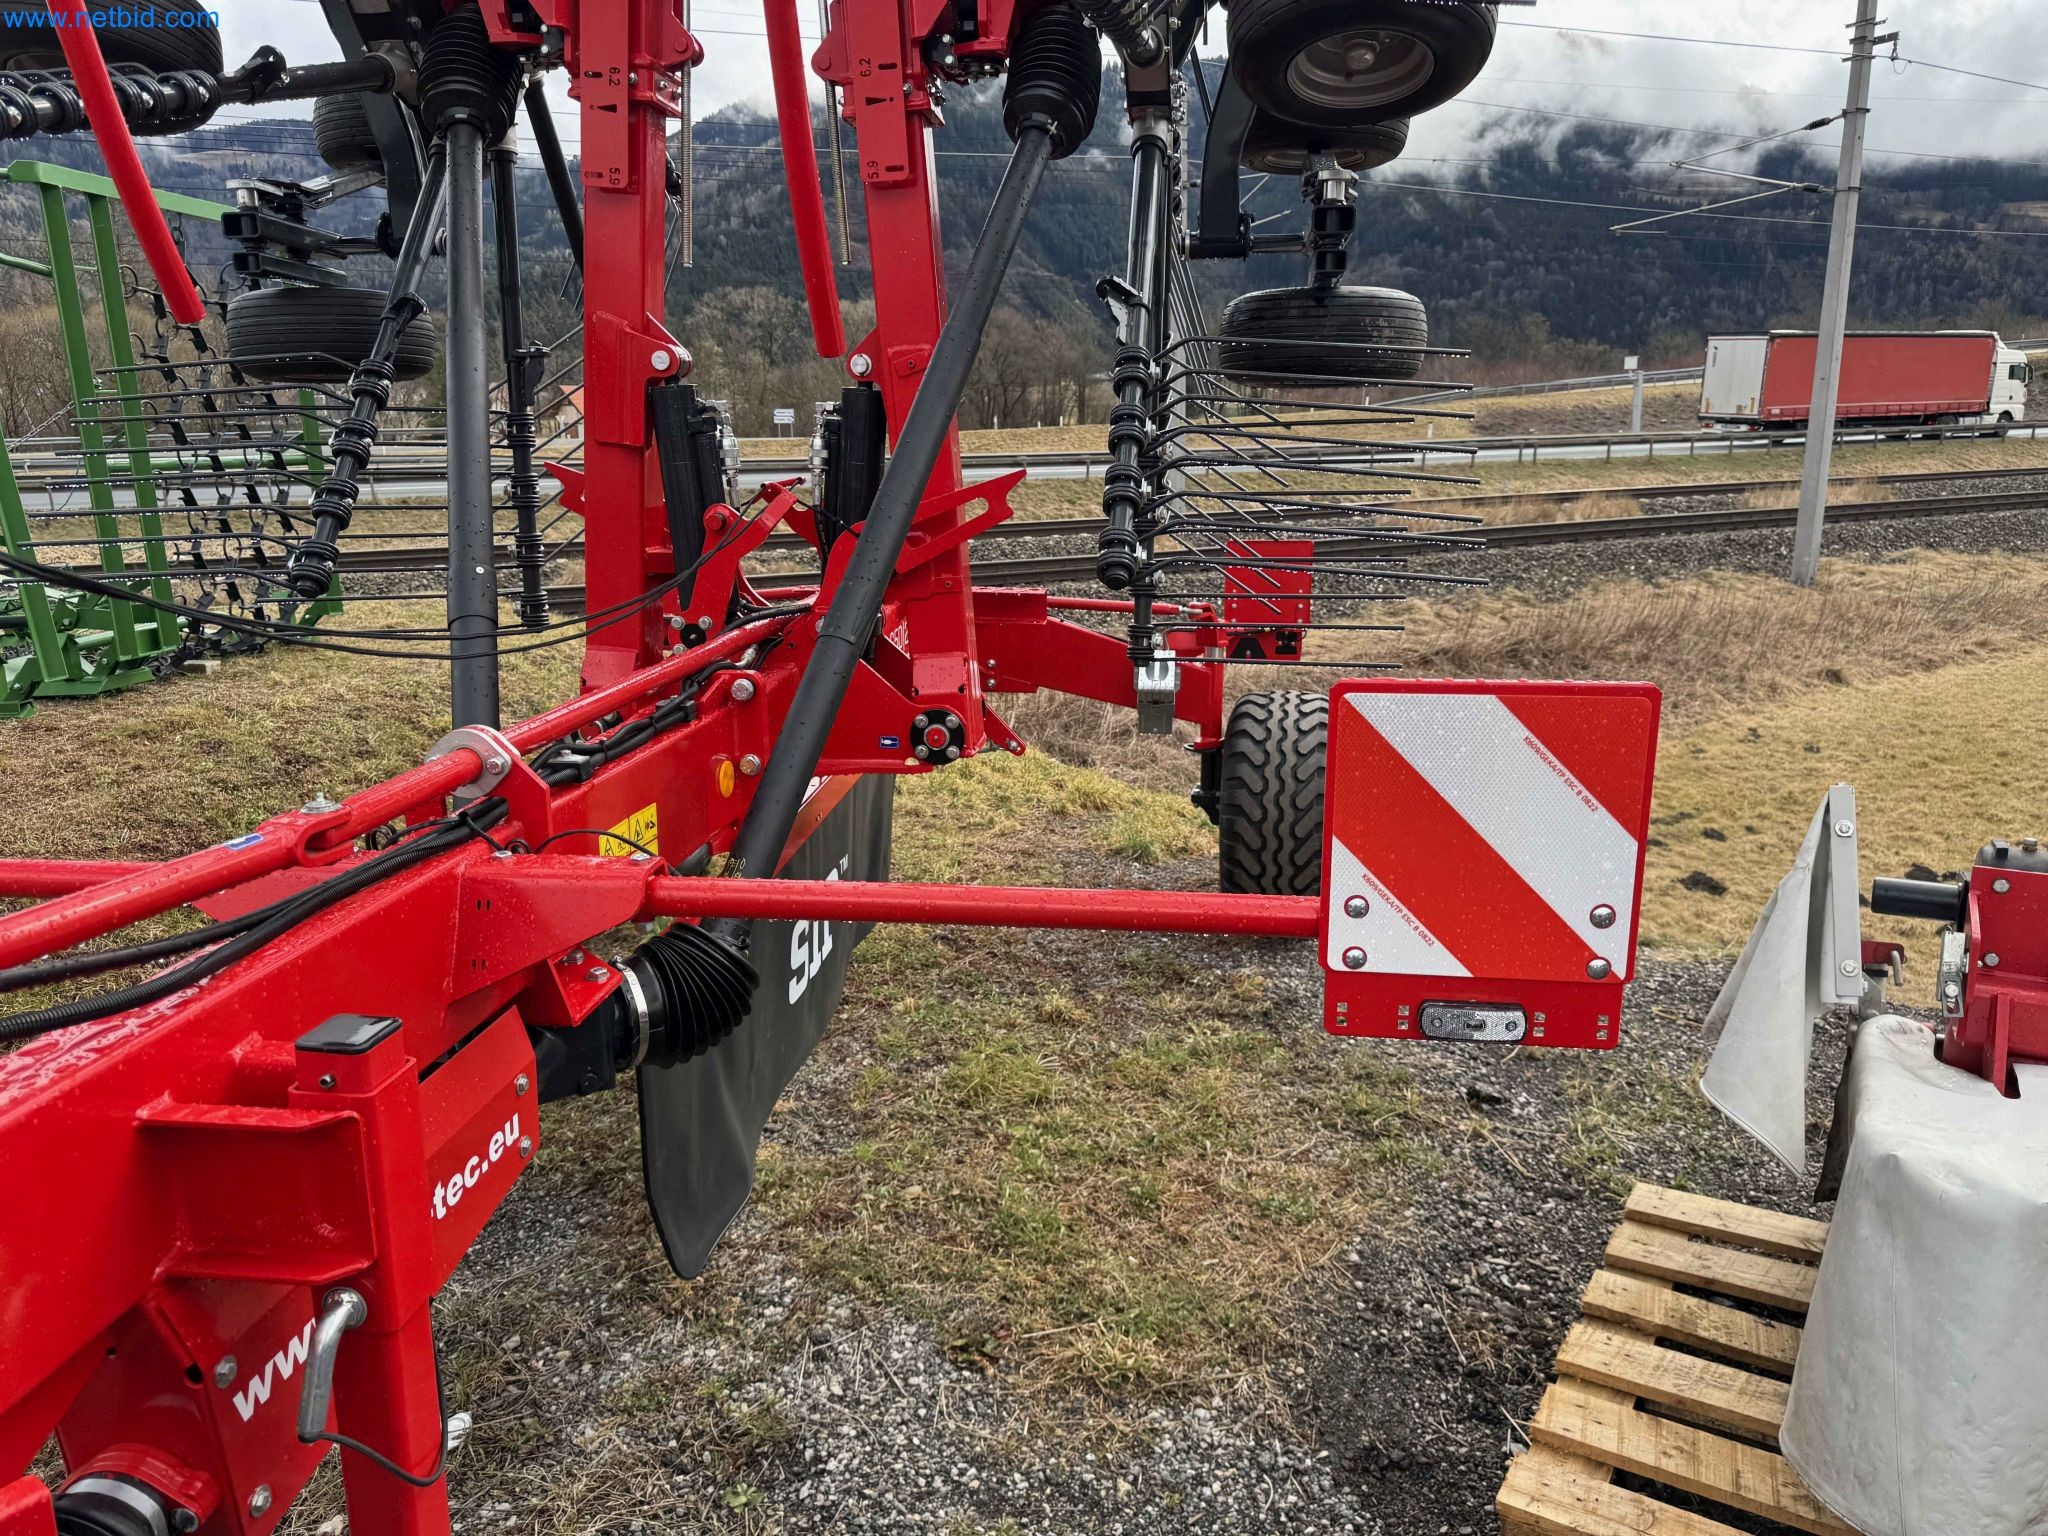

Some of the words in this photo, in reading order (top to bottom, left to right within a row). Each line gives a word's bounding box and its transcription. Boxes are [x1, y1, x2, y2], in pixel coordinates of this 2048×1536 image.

[608, 67, 621, 86] 6.2
[860, 58, 872, 77] 6.2
[609, 167, 621, 185] 5.9
[867, 161, 880, 179] 5.9
[1563, 777, 1578, 791] ESC
[1581, 795, 1598, 812] 0822
[1401, 913, 1416, 927] ESC
[1418, 930, 1435, 947] 0822
[232, 1316, 317, 1422] ww
